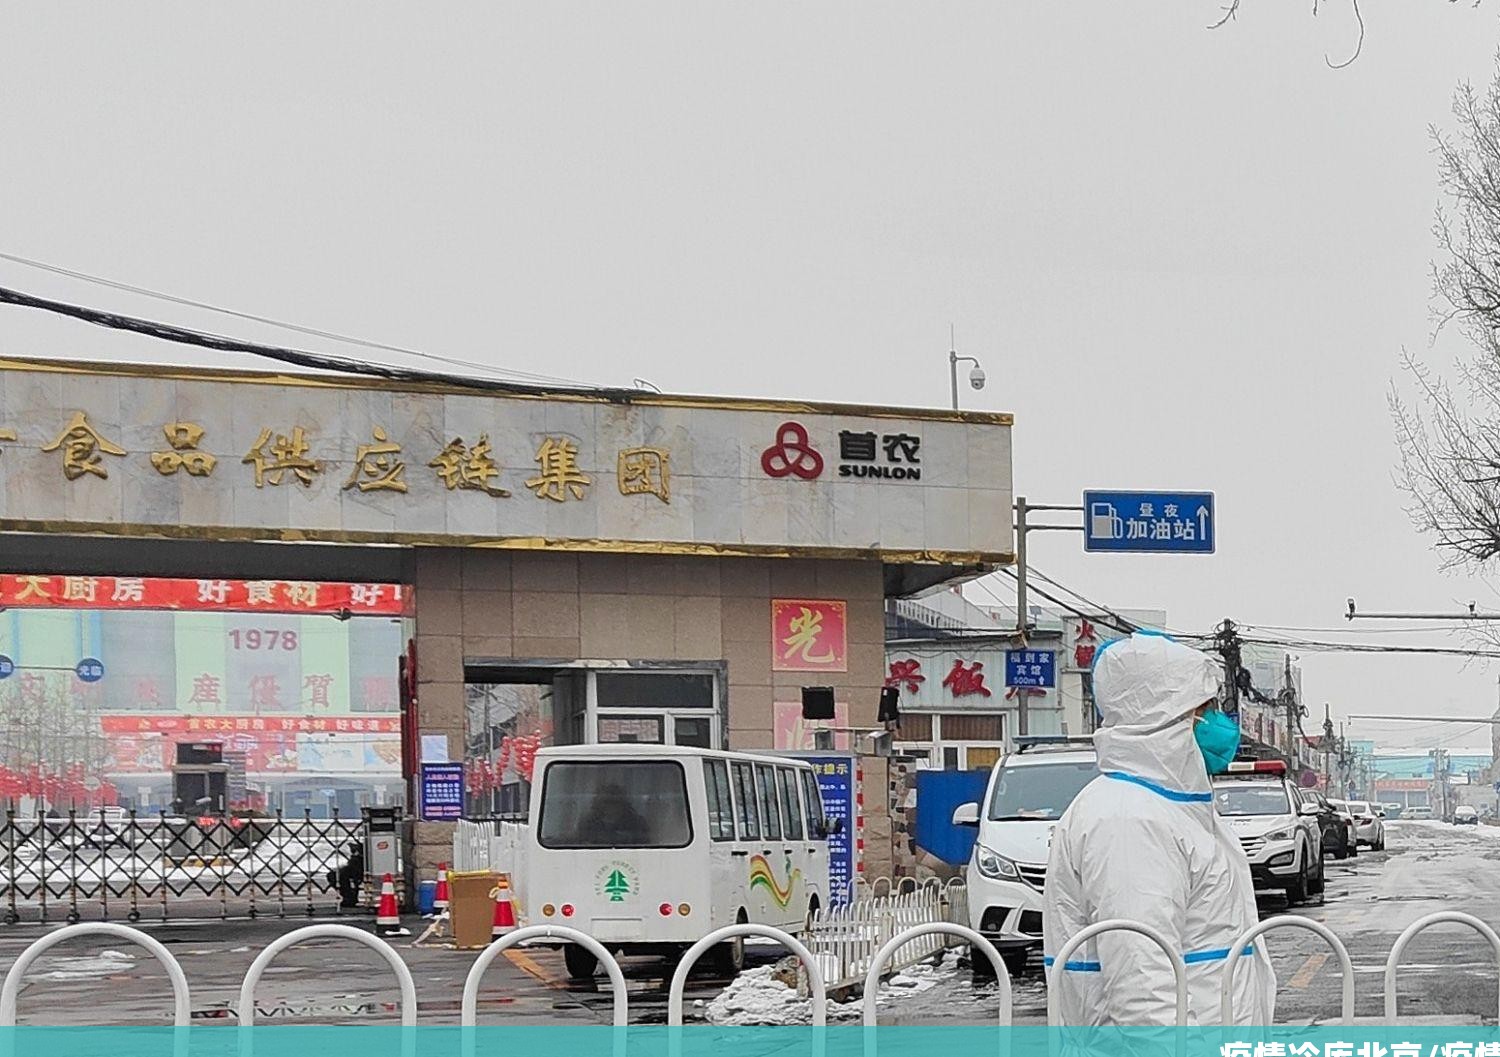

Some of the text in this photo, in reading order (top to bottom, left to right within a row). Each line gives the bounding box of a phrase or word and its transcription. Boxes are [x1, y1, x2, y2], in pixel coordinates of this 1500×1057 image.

[0, 411, 670, 504] 食品供应链集团
[838, 429, 920, 463] 首农
[838, 464, 921, 480] SUNLON
[1139, 502, 1178, 518] 昼夜
[1126, 517, 1195, 540] 加油站
[228, 629, 298, 651] 1978
[782, 607, 834, 664] 光
